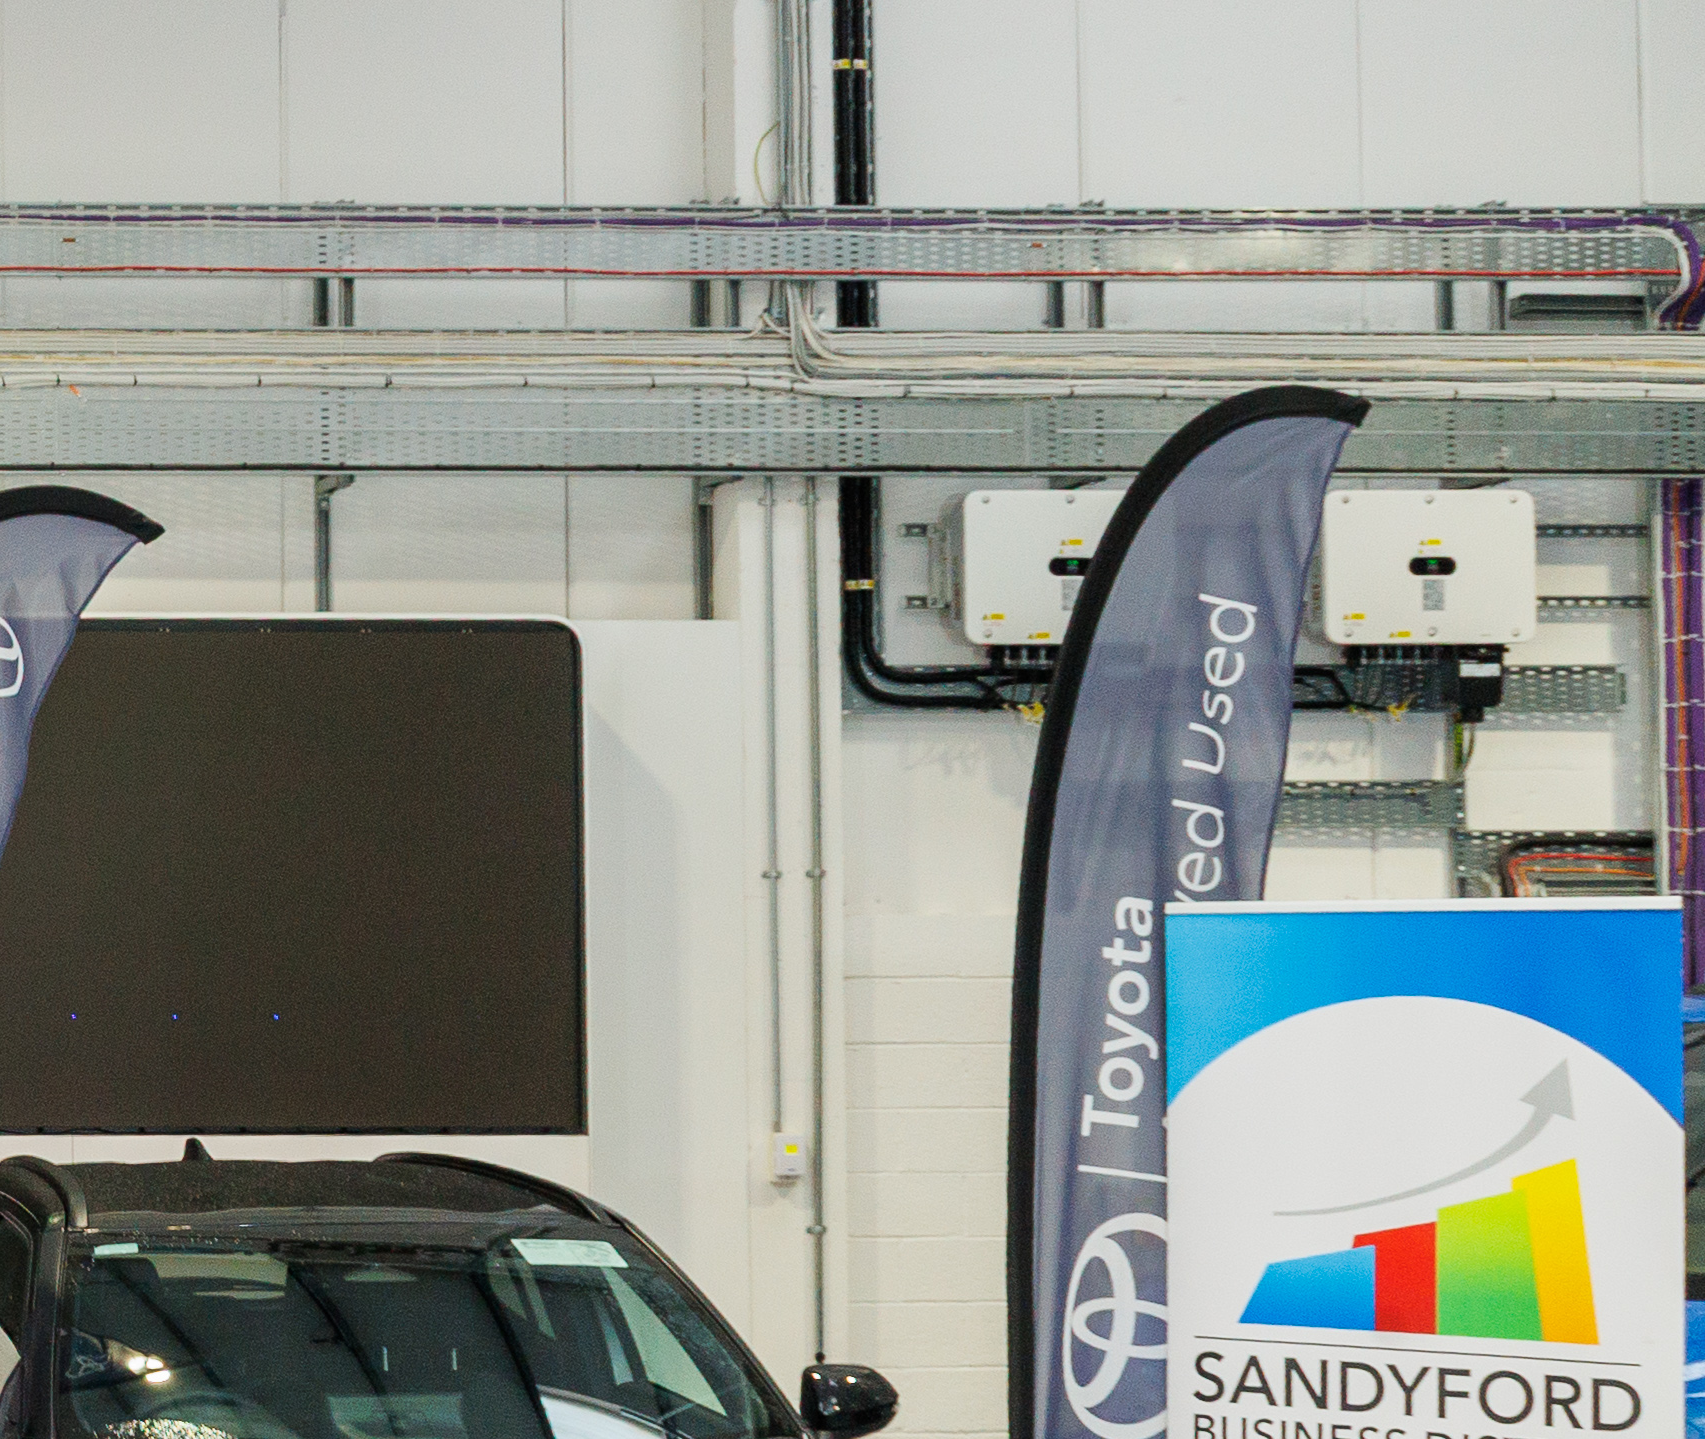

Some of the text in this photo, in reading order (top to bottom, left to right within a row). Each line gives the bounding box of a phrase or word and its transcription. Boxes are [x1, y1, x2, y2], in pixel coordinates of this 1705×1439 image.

[1182, 594, 1258, 774] Used
[1082, 897, 1157, 1136] Toyota
[1194, 1351, 1641, 1431] SANDYFORD
